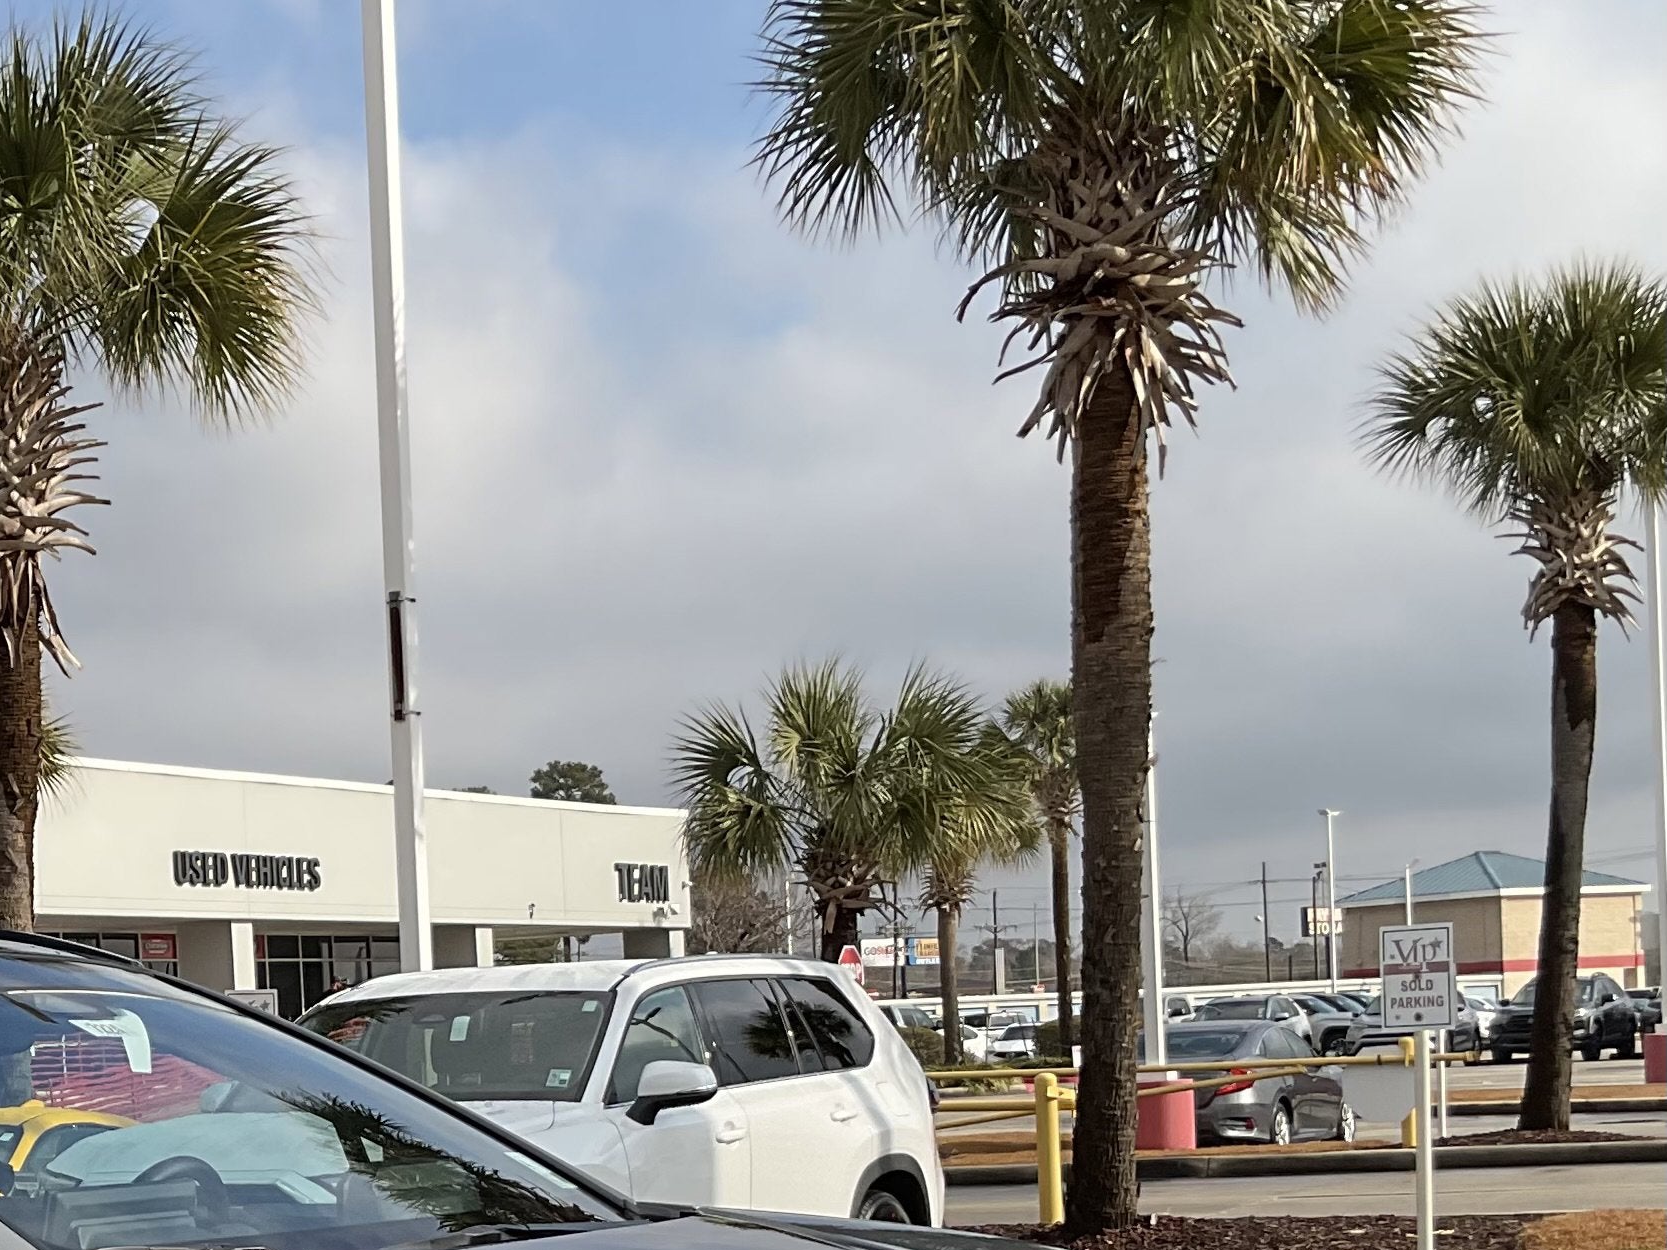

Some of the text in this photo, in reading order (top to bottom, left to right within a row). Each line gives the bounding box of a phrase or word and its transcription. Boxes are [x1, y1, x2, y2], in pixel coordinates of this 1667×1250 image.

[173, 851, 321, 892] USED VEHICLES
[614, 863, 670, 903] TEAM
[1400, 979, 1434, 992] SOLD
[1390, 995, 1444, 1009] PARKING
